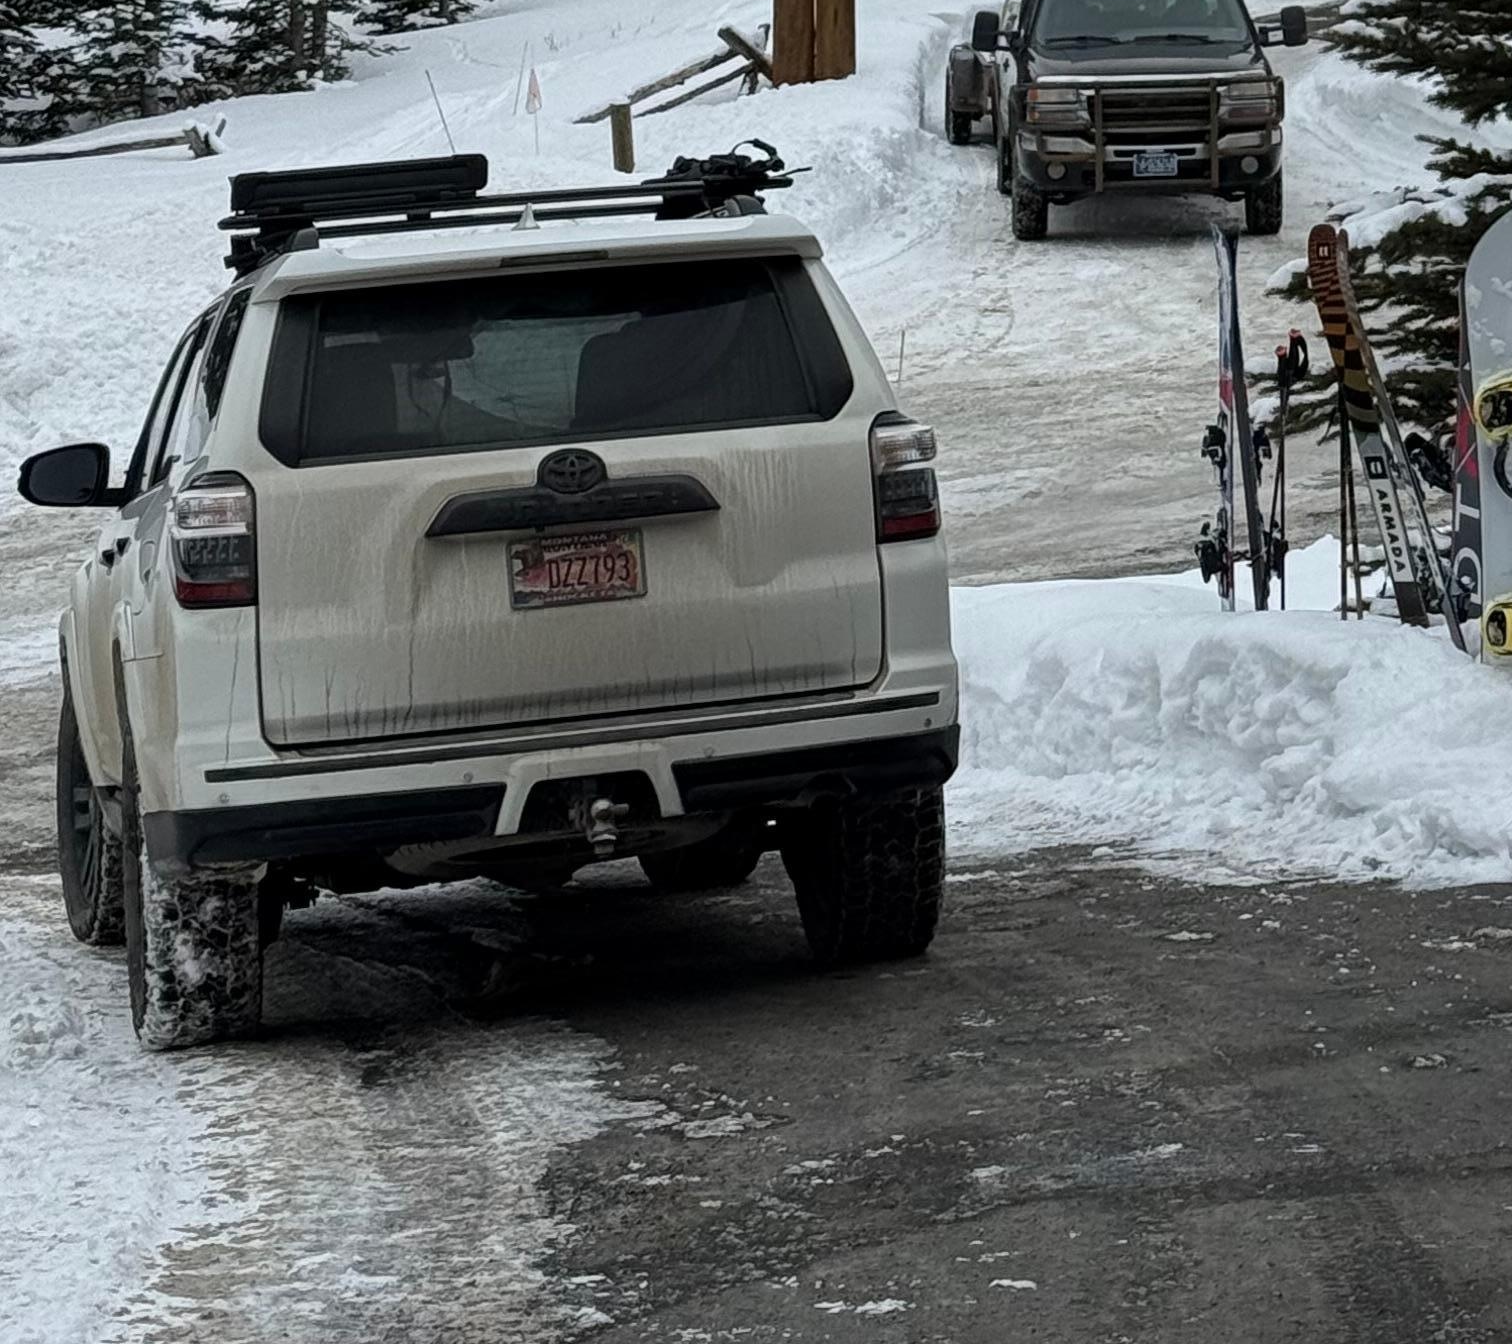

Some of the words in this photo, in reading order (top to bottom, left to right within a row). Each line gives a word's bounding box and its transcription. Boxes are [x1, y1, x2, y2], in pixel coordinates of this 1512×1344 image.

[541, 533, 608, 545] MONTANA
[1375, 488, 1406, 573] ARMADA
[547, 552, 631, 589] DZZ793
